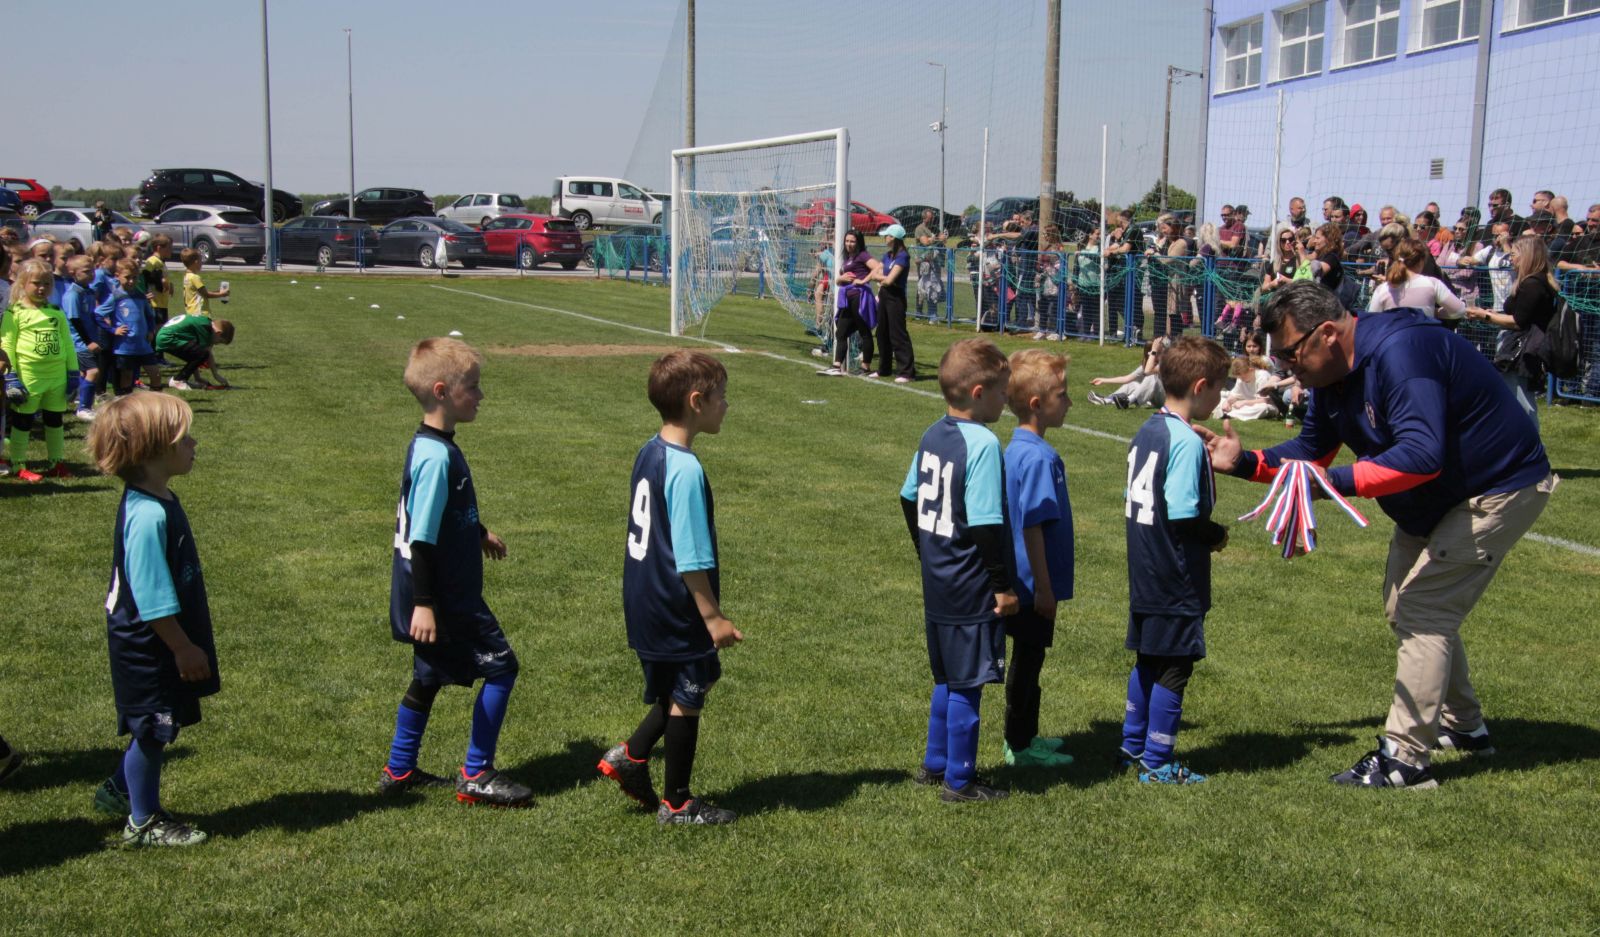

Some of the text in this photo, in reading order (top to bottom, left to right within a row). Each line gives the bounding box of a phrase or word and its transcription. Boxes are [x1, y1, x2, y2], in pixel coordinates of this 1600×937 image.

[627, 478, 650, 561] 9
[917, 450, 955, 538] 21
[1125, 445, 1158, 526] 14
[467, 782, 494, 795] FILA
